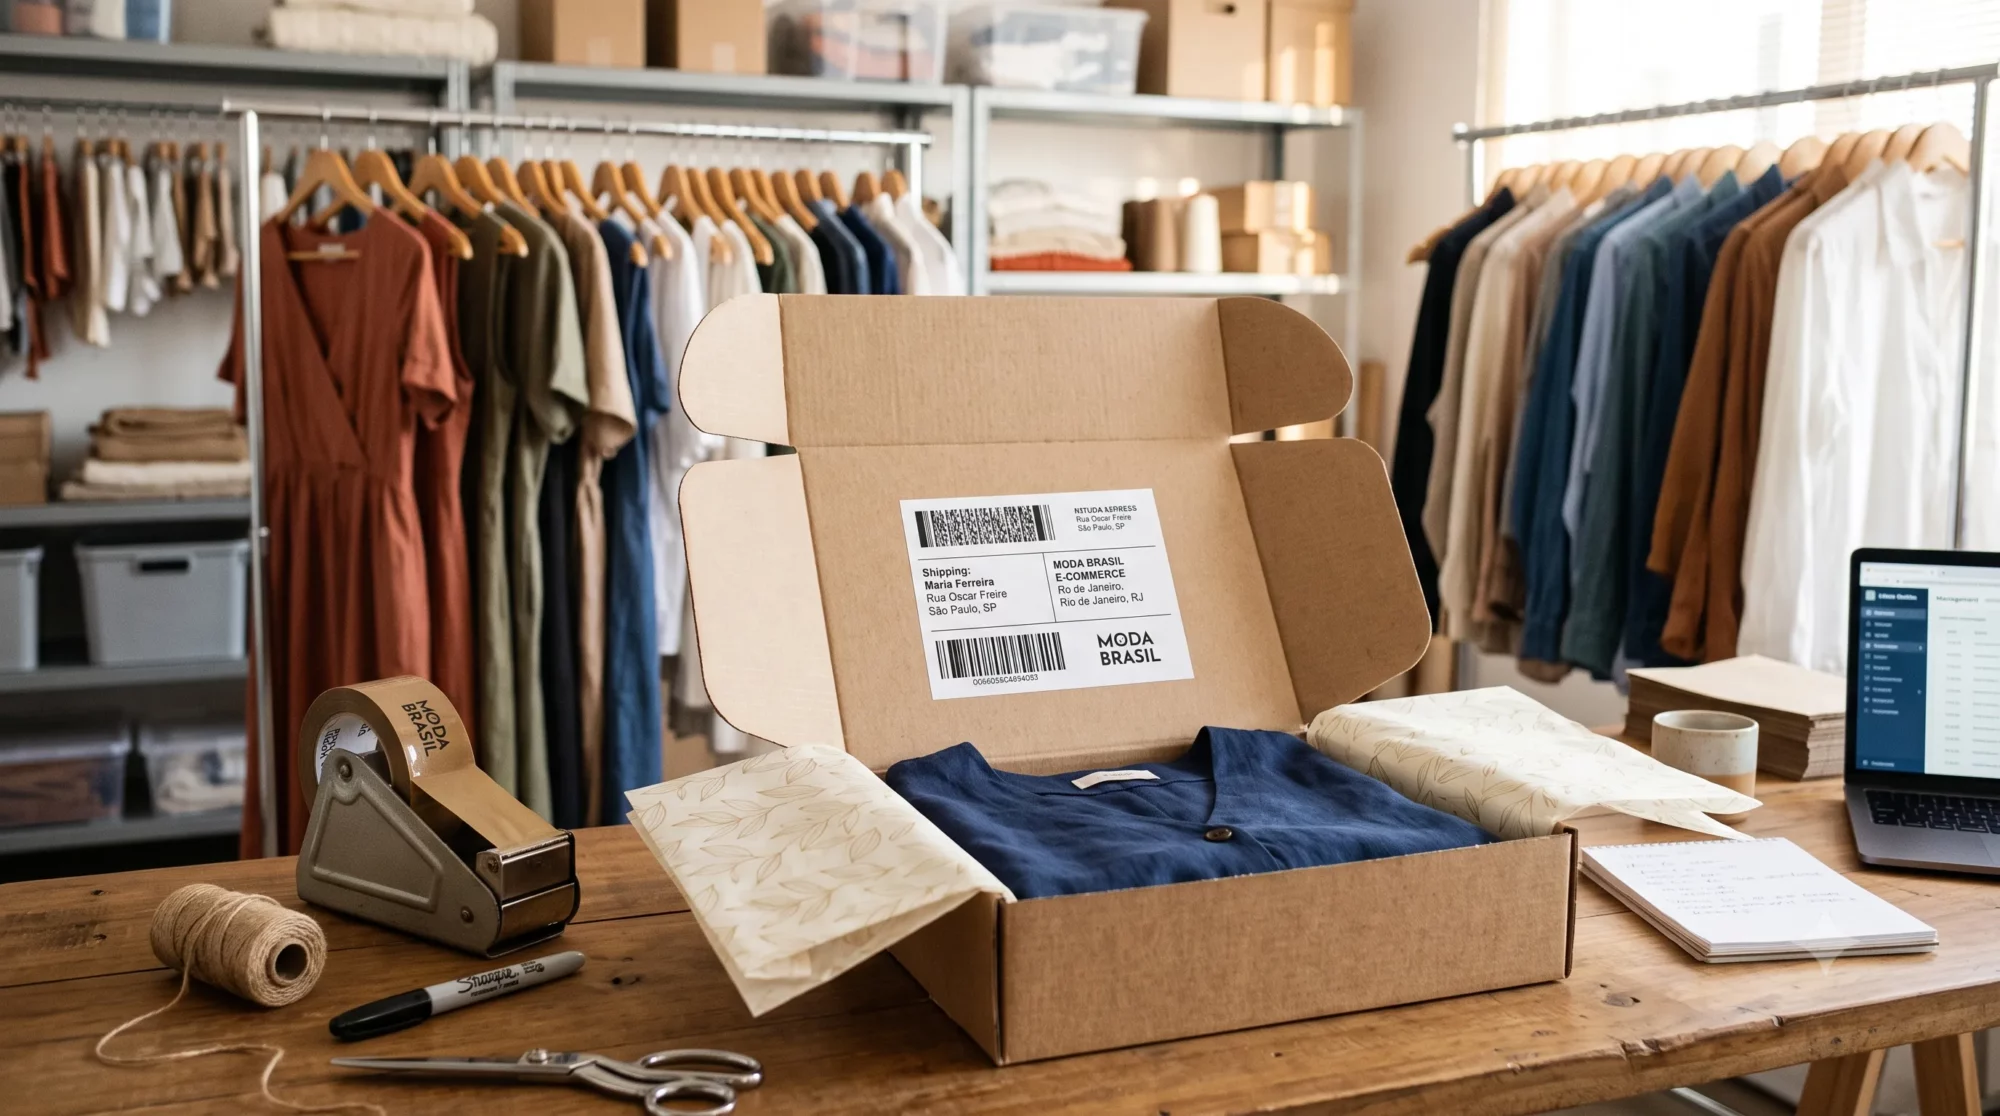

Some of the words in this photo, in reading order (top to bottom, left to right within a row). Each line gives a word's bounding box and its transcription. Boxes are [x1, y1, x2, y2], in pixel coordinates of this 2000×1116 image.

[1112, 513, 1132, 521] Freire
[1115, 522, 1125, 530] SP
[1053, 559, 1085, 569] MODA
[1086, 556, 1125, 567] BRASIL
[922, 567, 971, 578] Shipping:
[1055, 569, 1126, 582] E-COMMERCE
[924, 580, 953, 590] Maria
[955, 578, 995, 589] Ferreira
[1057, 585, 1071, 594] Ro
[1073, 584, 1086, 593] de
[926, 593, 947, 603] Rua
[948, 591, 978, 602] Oscar
[979, 588, 1008, 600] Freire
[1060, 597, 1076, 607] Rio
[1077, 596, 1090, 606] de
[1092, 594, 1129, 606] Janeiro,
[1130, 592, 1144, 602] RJ
[928, 605, 948, 616] São
[950, 604, 981, 615] Paulo,
[983, 602, 997, 613] SP
[1097, 630, 1154, 648] MODA
[1100, 648, 1161, 666] BRASIL
[401, 703, 437, 757] BRASIL
[416, 700, 450, 750] MODA
